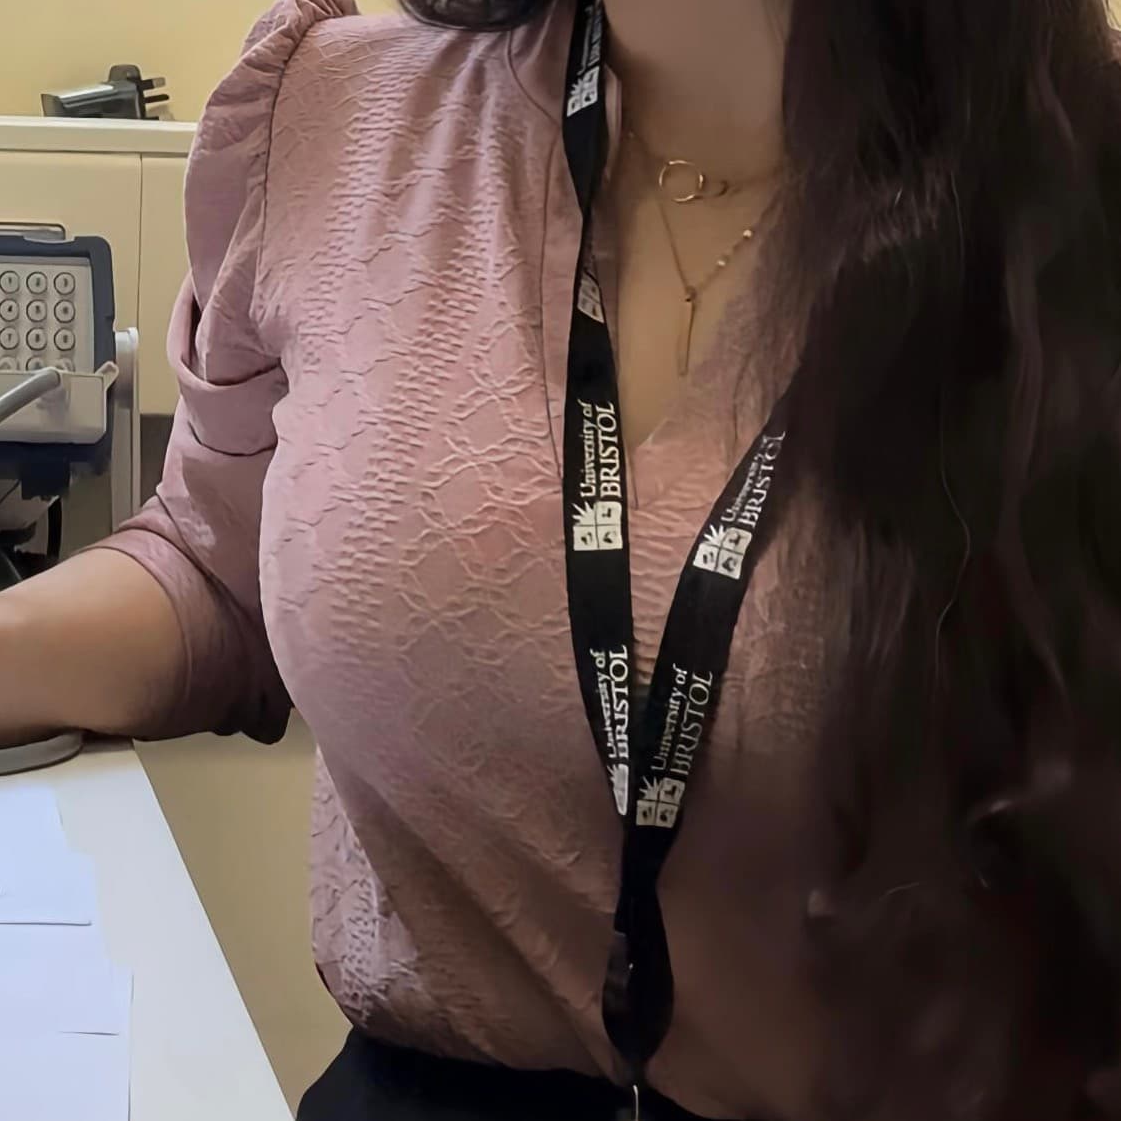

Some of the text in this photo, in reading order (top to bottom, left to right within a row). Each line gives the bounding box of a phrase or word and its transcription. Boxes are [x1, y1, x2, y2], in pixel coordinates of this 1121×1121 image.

[577, 398, 598, 497] University of
[595, 401, 622, 498] BRISTOL
[737, 430, 786, 529] BRISTOL
[609, 644, 629, 759] BRISTOL
[669, 670, 713, 776] BRISTOL
[672, 662, 688, 685] of
